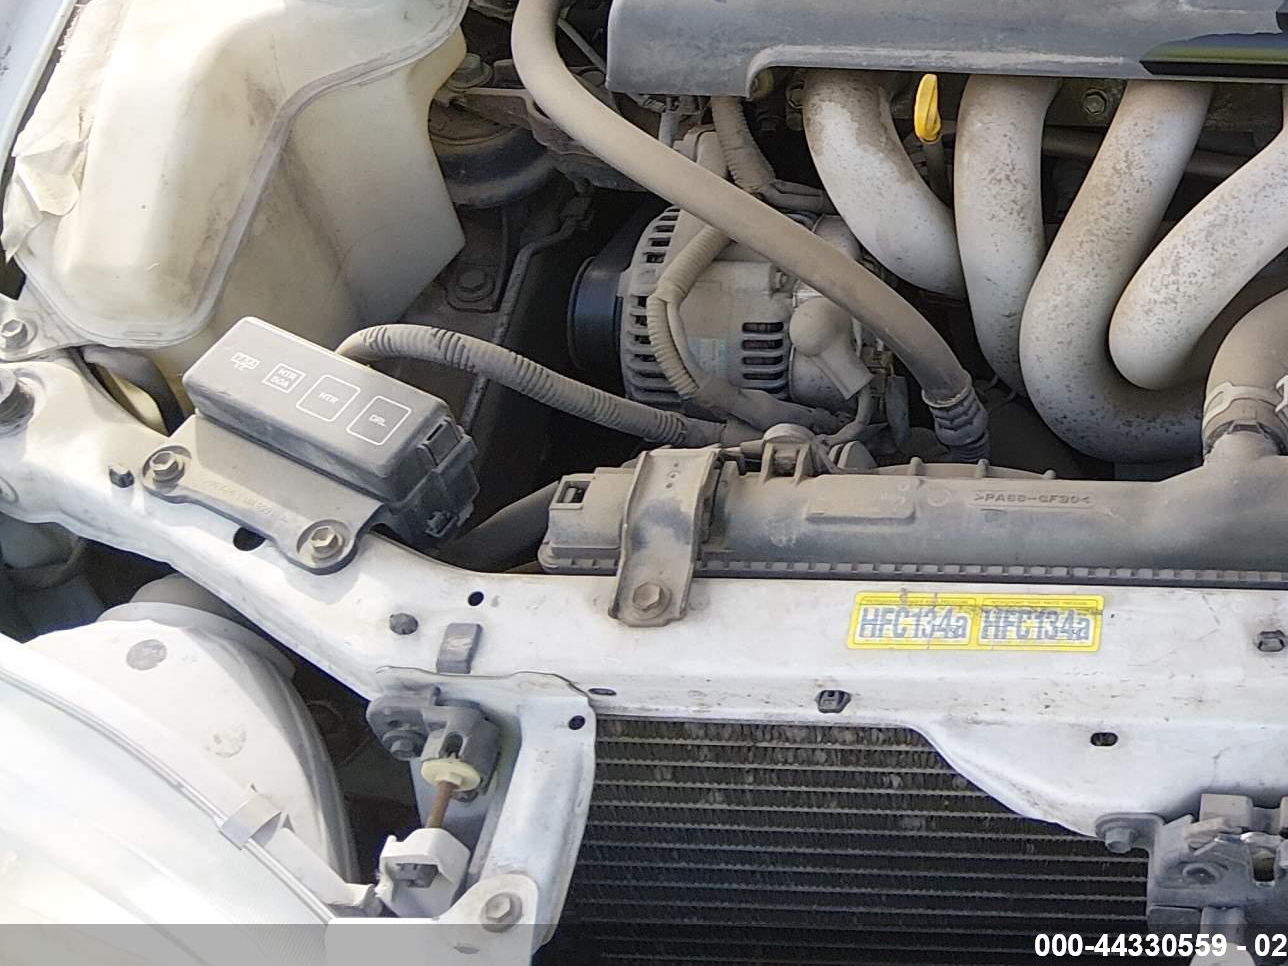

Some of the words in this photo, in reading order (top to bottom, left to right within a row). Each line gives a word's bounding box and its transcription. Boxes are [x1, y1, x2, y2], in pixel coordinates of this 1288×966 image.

[318, 392, 339, 404] HTR
[859, 607, 968, 639] HFC134a
[981, 607, 1091, 640] HFC134a
